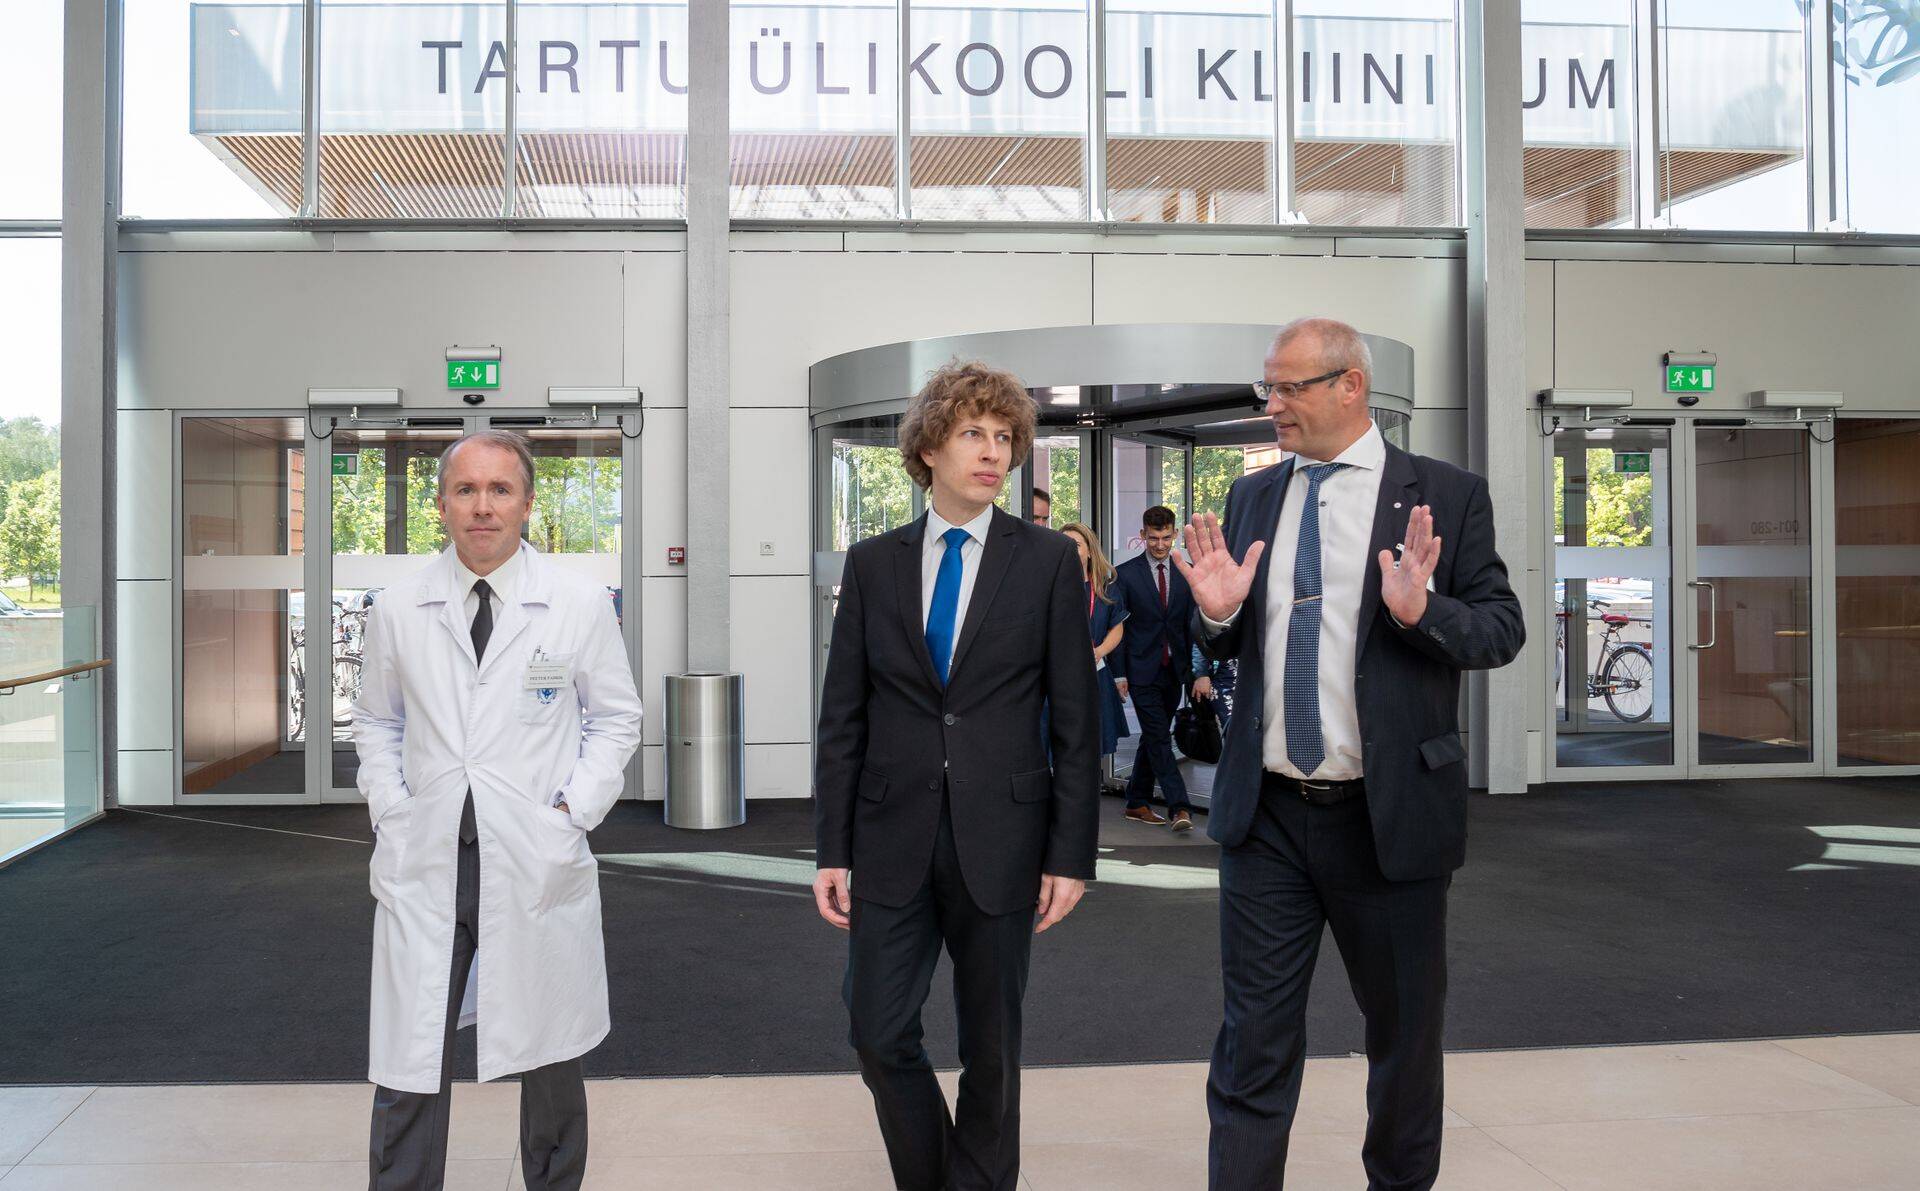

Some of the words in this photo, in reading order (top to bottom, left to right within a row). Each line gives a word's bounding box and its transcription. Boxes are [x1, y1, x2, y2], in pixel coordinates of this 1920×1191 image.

[422, 40, 688, 95] TARTU
[750, 27, 1153, 99] ÜLIKOOI
[1198, 47, 1615, 109] KLIINIUM
